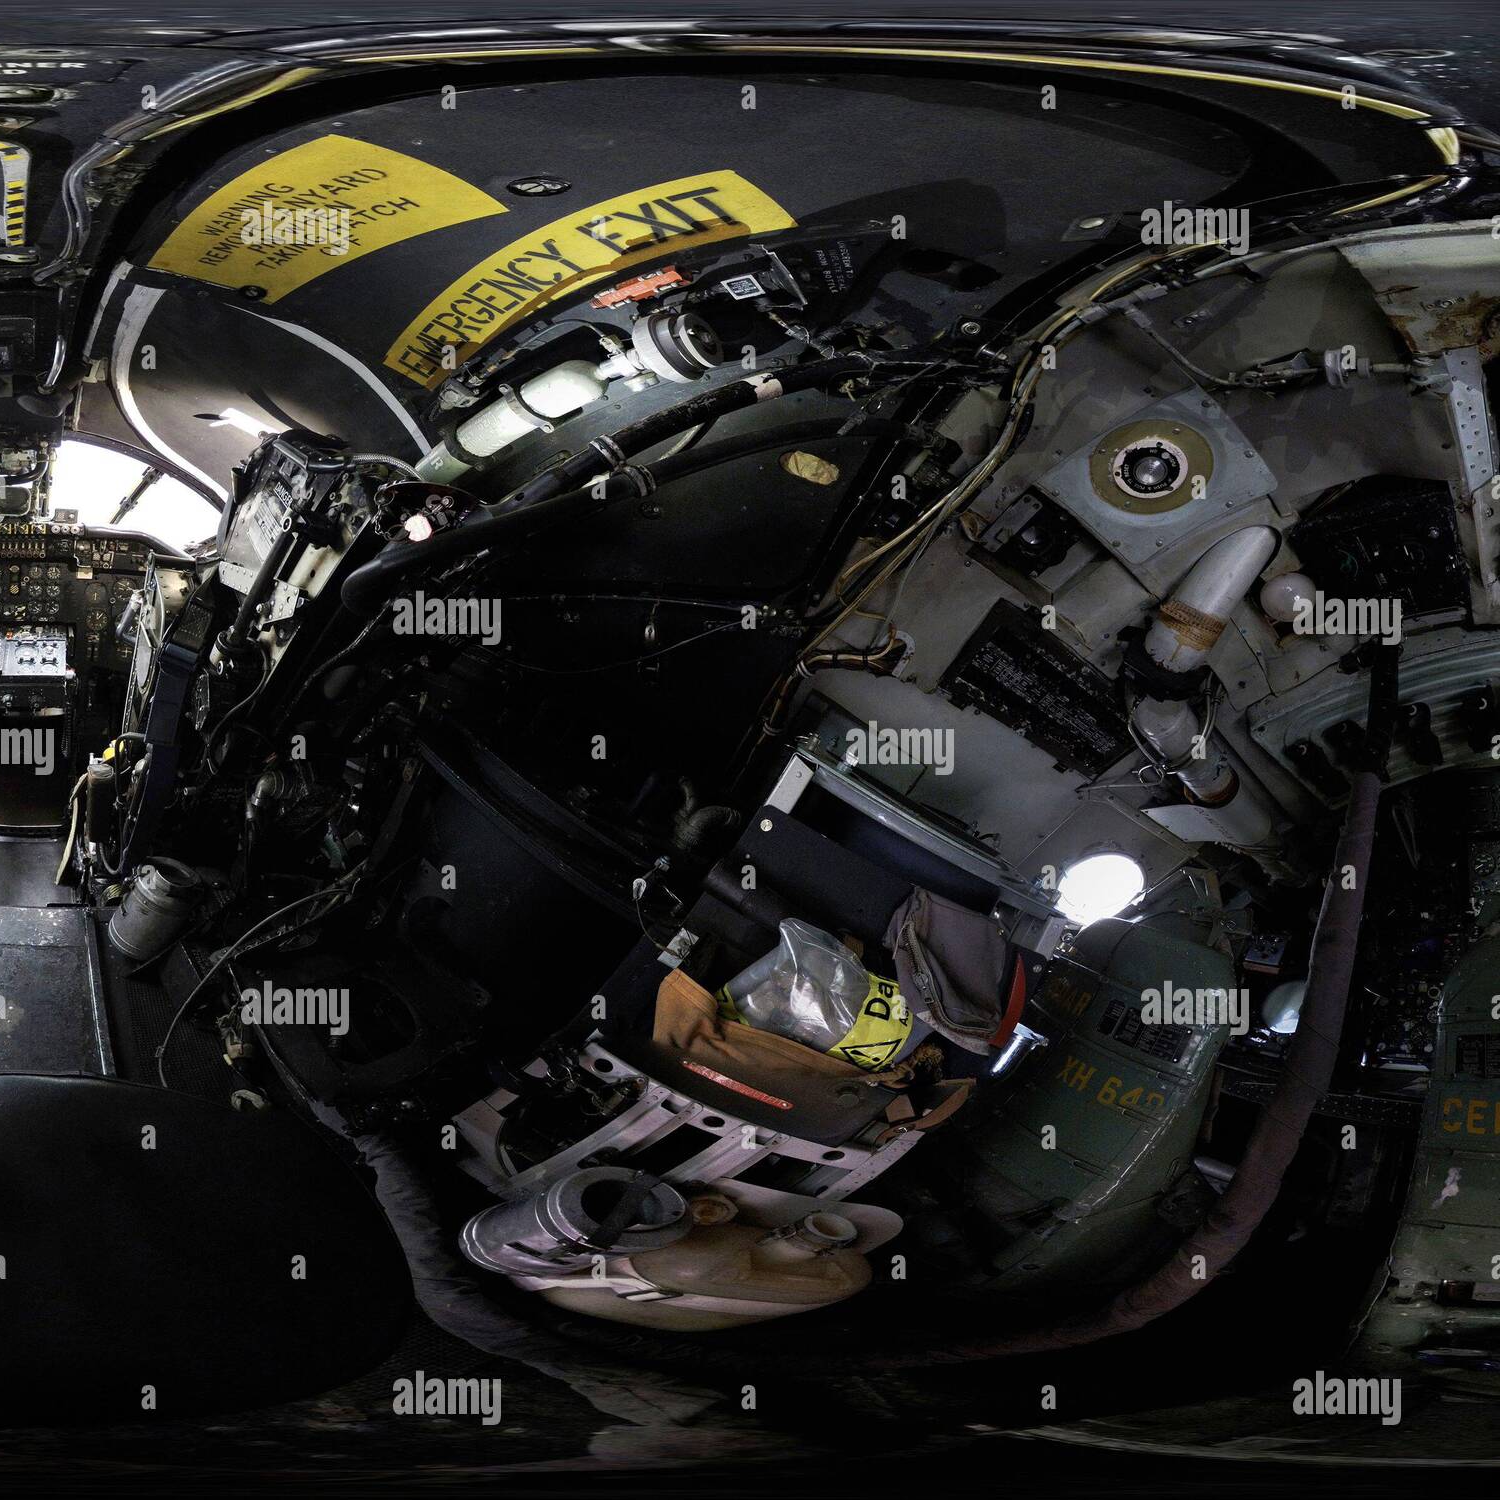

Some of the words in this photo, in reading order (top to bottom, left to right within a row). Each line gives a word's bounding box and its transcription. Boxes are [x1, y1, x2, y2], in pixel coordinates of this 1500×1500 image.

[198, 182, 295, 237] WARNING
[326, 196, 421, 234] HATCH
[398, 238, 584, 379] EMERGENCY
[575, 186, 720, 256] EXIT
[274, 481, 294, 508] DANGER
[864, 982, 894, 1021] Da
